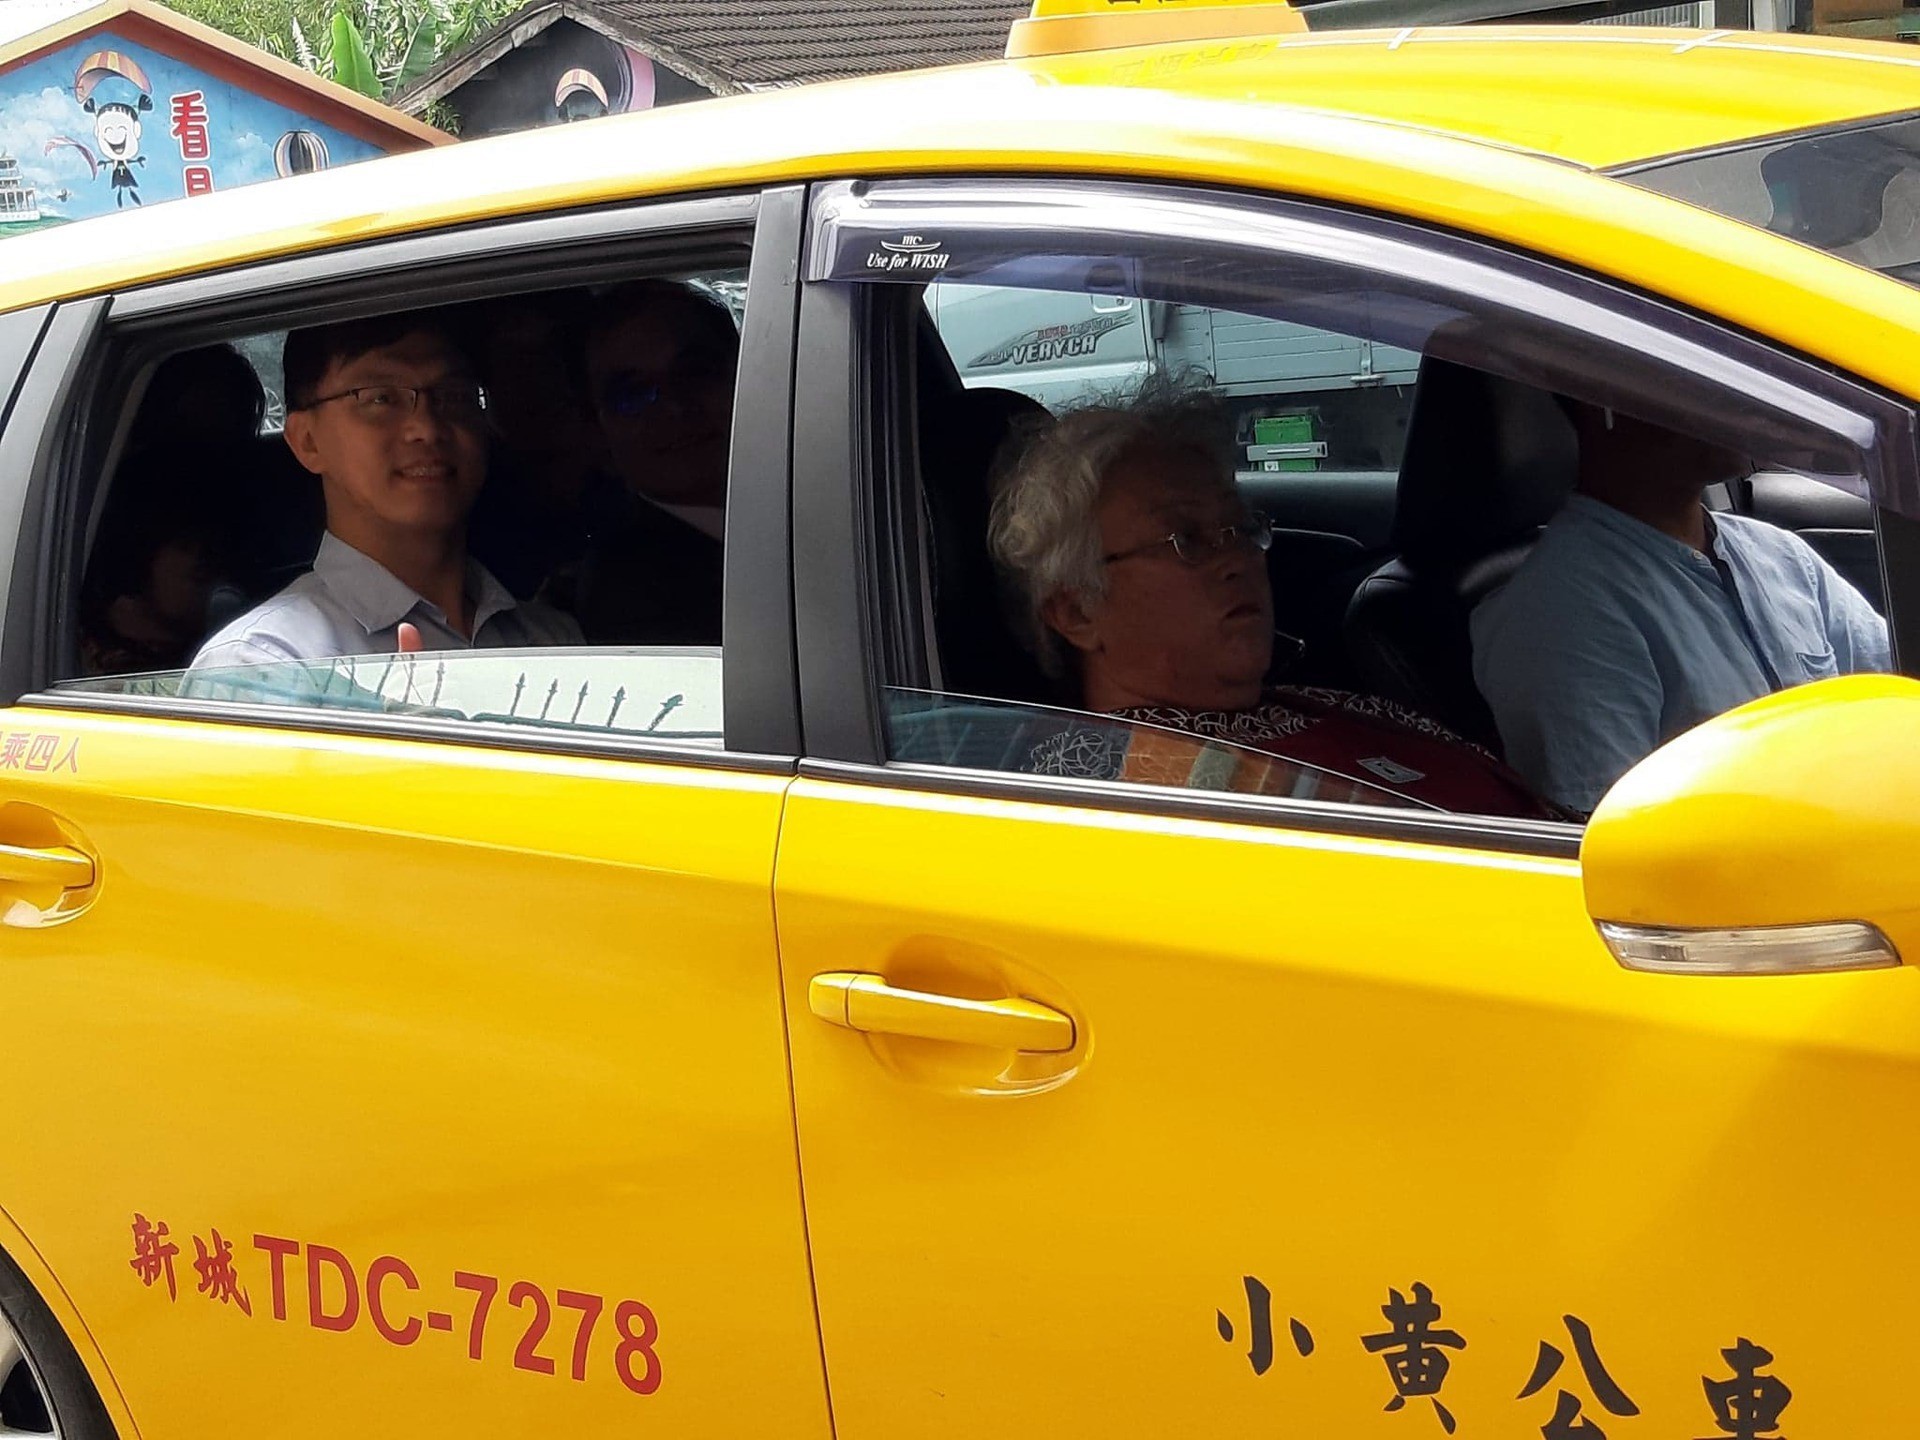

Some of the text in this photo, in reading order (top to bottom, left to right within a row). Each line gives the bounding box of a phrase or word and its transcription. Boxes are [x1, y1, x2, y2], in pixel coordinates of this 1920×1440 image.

[867, 253, 950, 271] Use for WISH
[1012, 334, 1097, 364] VERYCA
[0, 731, 79, 773] 乘四人
[253, 1233, 662, 1396] TDC-7278
